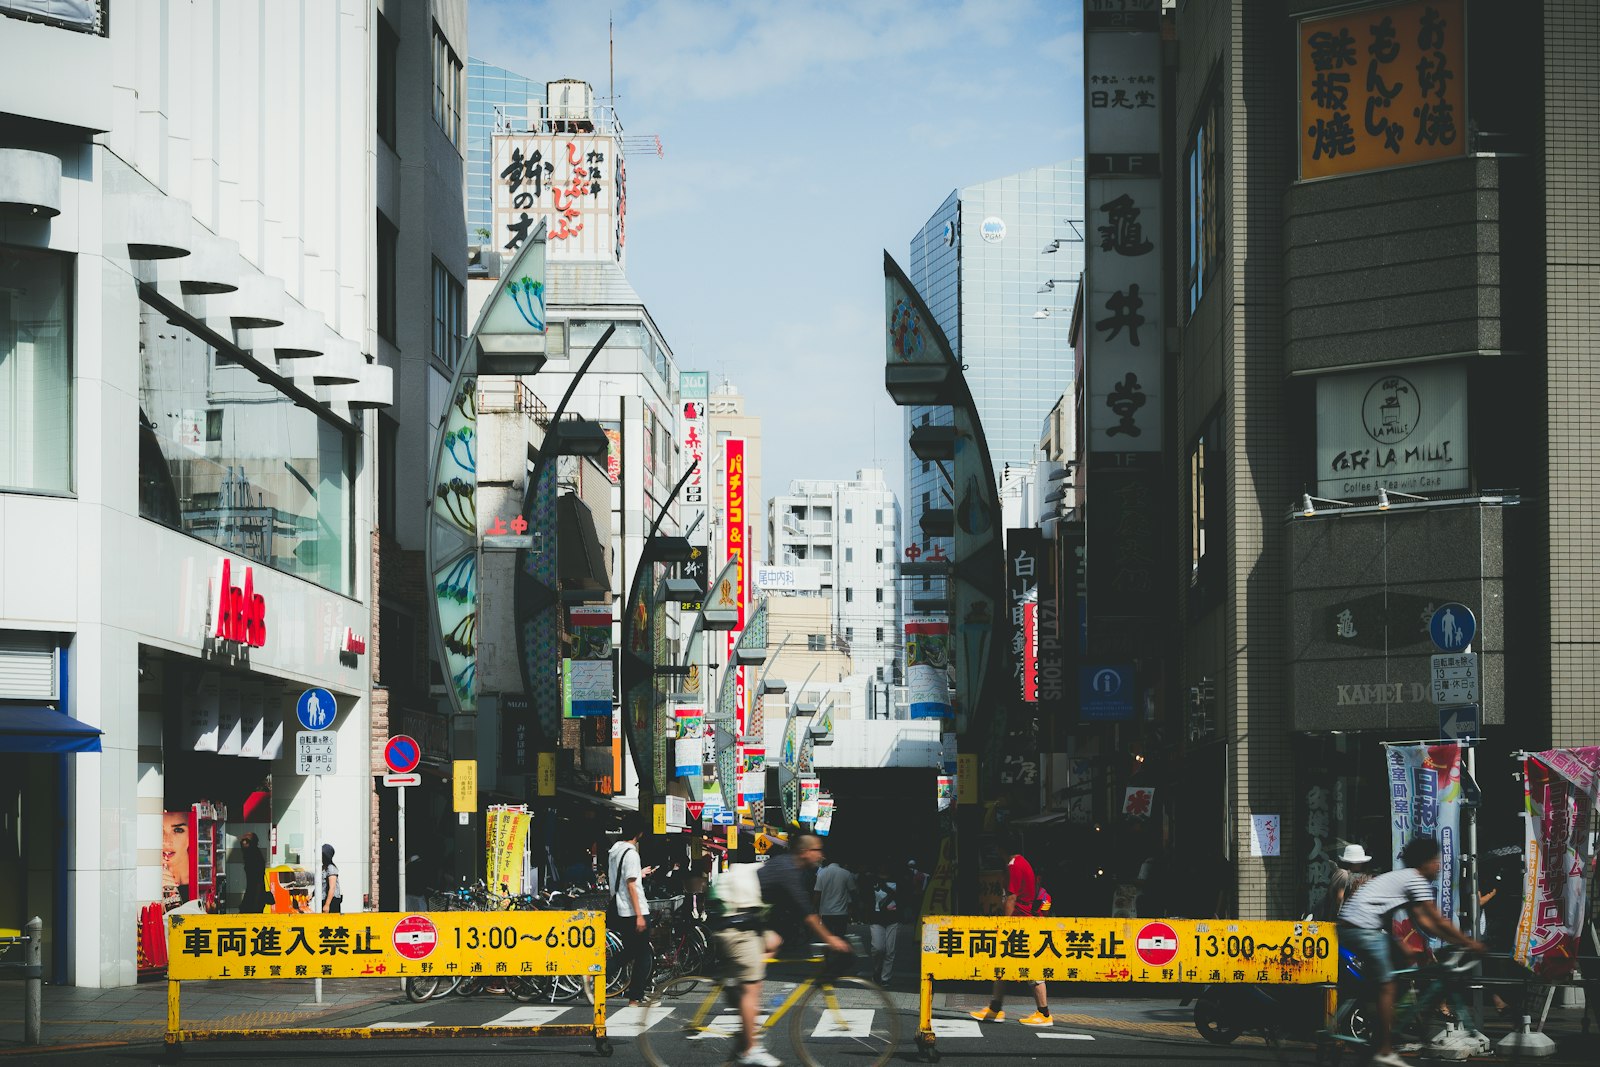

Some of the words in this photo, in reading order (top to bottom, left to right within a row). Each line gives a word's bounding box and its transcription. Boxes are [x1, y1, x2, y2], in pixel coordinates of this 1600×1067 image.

[1364, 15, 1404, 155] もんじゃ
[1373, 426, 1384, 437] LA
[1375, 448, 1397, 468] LA
[1405, 440, 1453, 463] MILLE
[1344, 482, 1372, 493] Coffee
[1383, 480, 1399, 489] Tea
[485, 515, 528, 535] 上中
[758, 568, 795, 586] 尾中内科
[1433, 656, 1474, 667] 自転車を除く
[1436, 669, 1445, 679] 13
[1466, 668, 1472, 677] 6
[1437, 691, 1446, 702] 12
[1467, 690, 1473, 700] 6
[300, 735, 333, 744] 自転車を除く
[301, 745, 311, 754] 13
[326, 745, 332, 754] 6
[301, 763, 311, 772] 12
[326, 763, 332, 772] 6
[1531, 780, 1569, 957] 日焼けサロン
[182, 926, 383, 957] 車両進入禁止
[938, 928, 1126, 960] 車両進入禁止
[219, 964, 333, 977] 上野警察署
[396, 961, 559, 974] 上野中通商店街
[970, 967, 1079, 979] 上野警察署
[1138, 968, 1293, 982] 上野中通商店街
